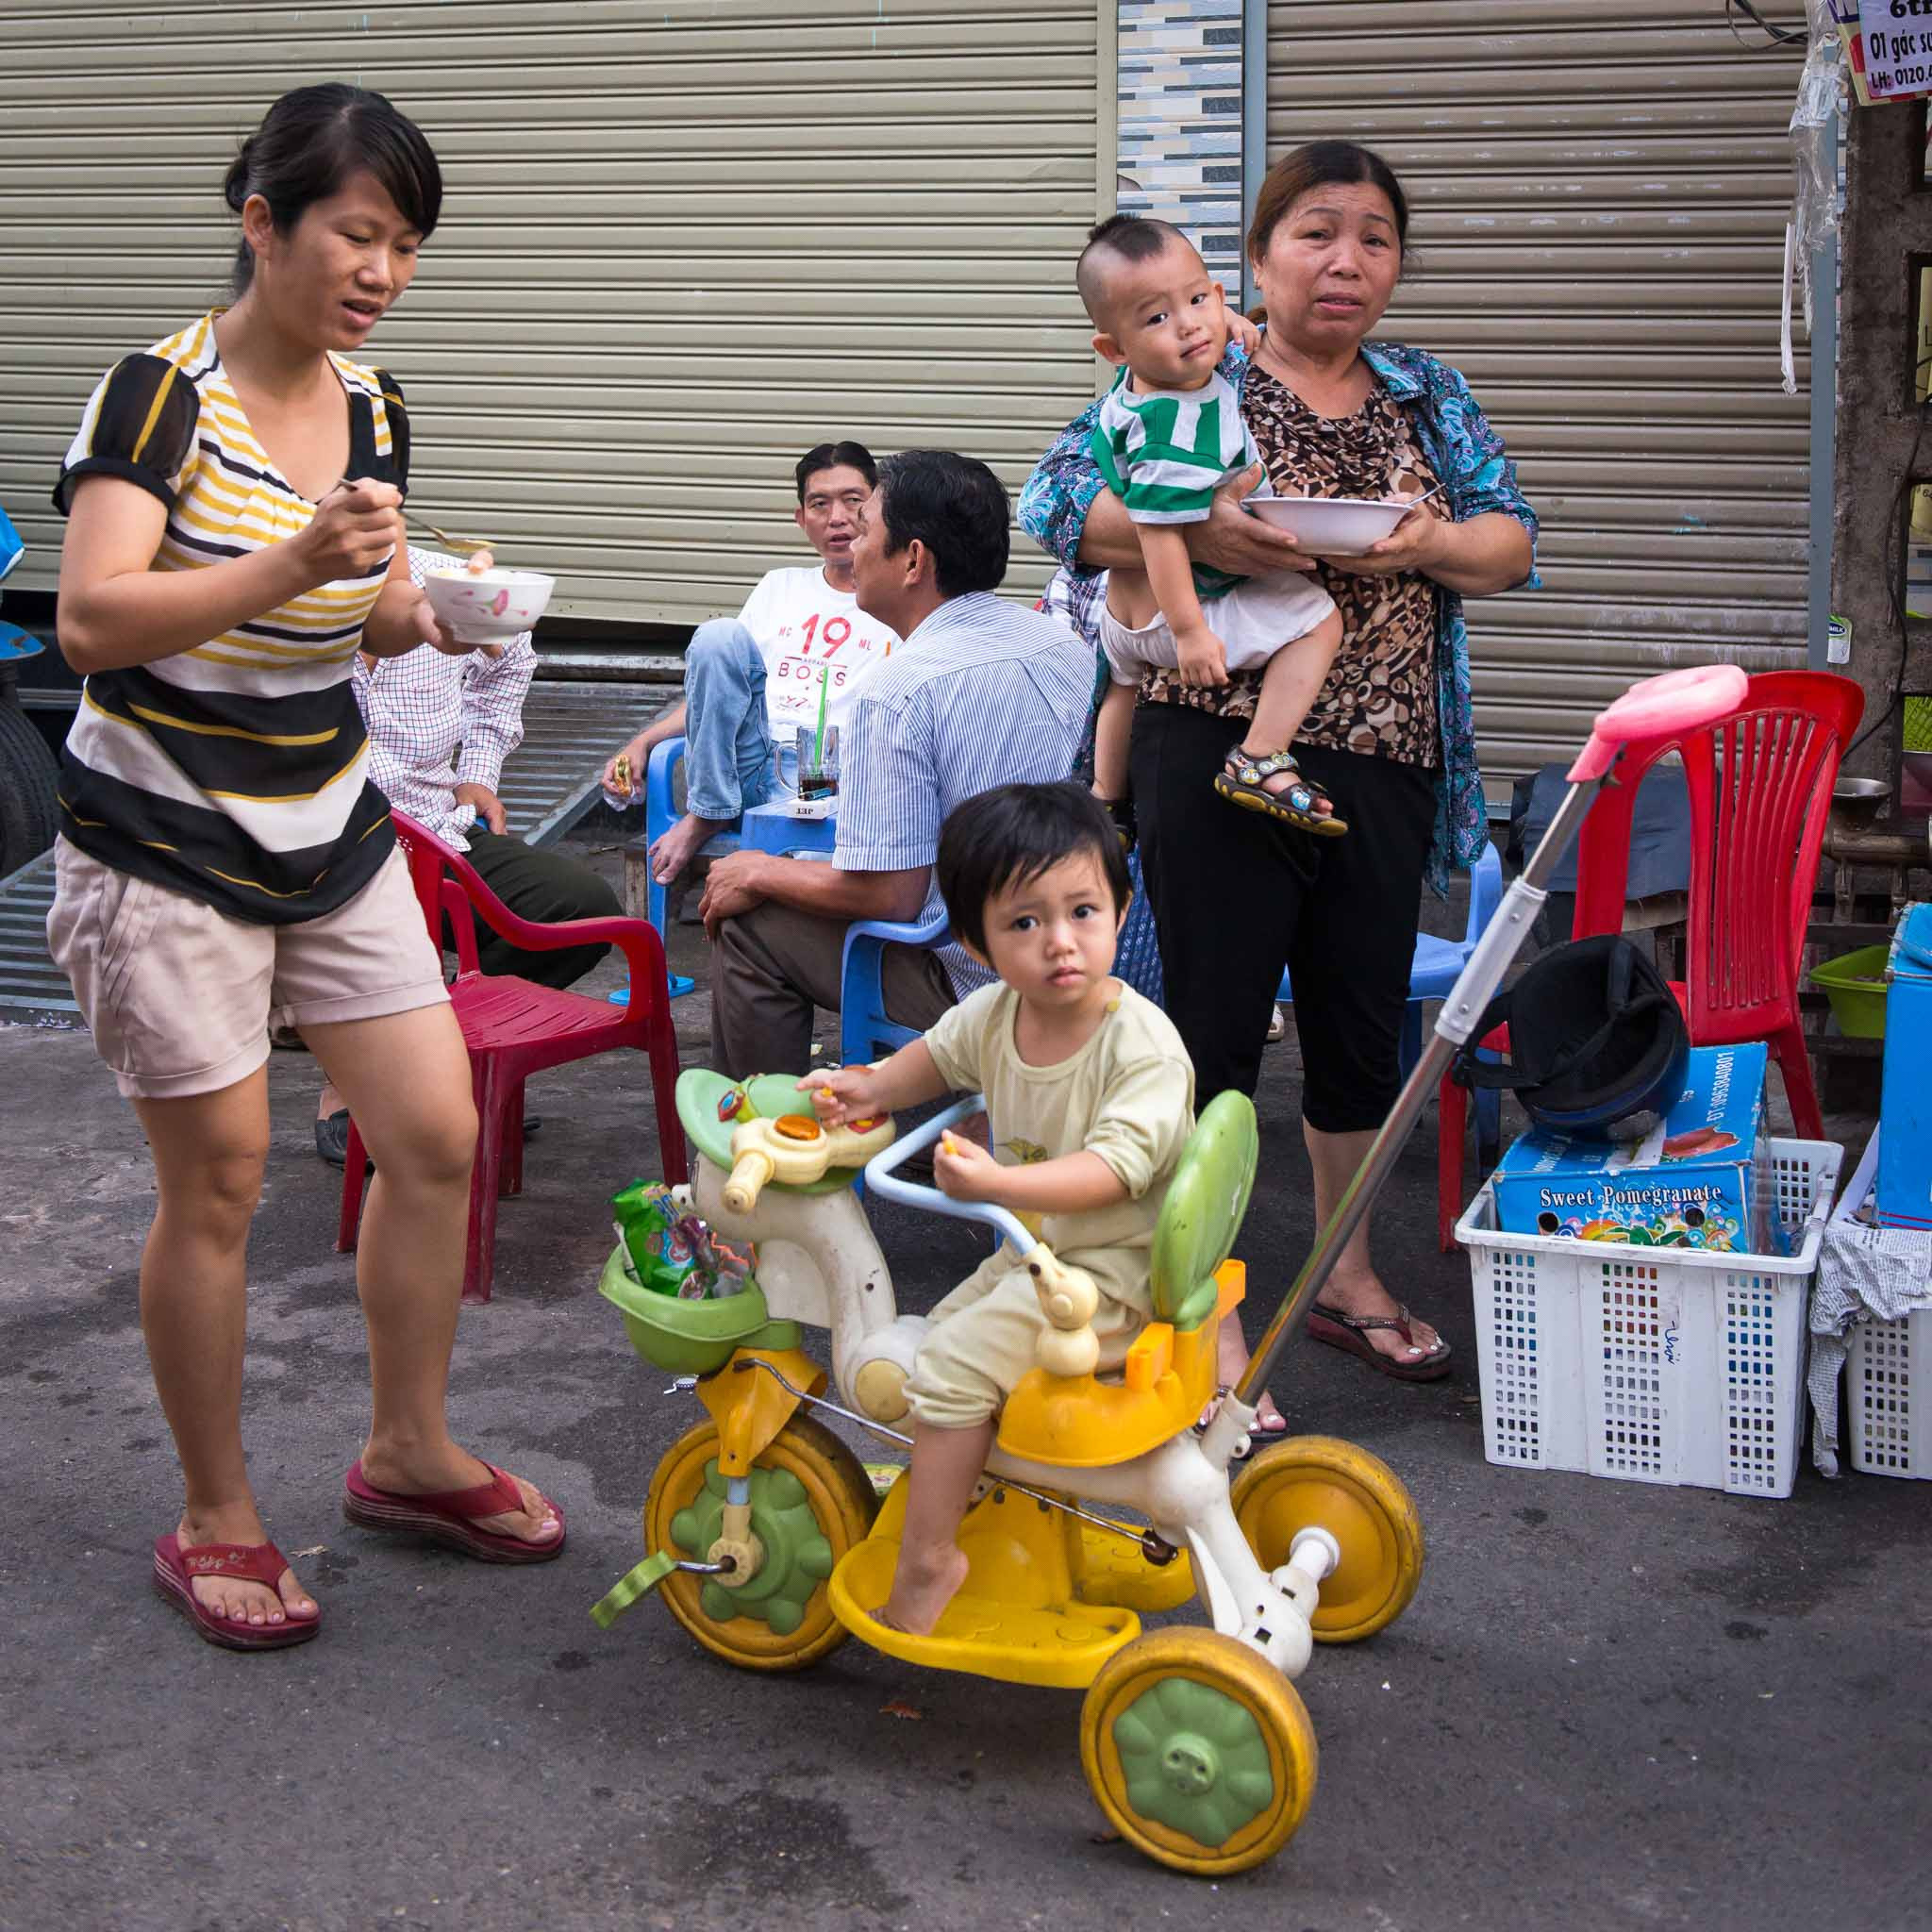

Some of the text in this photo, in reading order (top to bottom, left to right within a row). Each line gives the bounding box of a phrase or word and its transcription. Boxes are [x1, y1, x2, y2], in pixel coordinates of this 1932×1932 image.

[1870, 32, 1887, 59] 01
[1891, 29, 1916, 63] gác
[1871, 71, 1891, 89] LH:
[801, 613, 852, 658] 19
[778, 662, 846, 687] BOSS
[1540, 1184, 1723, 1208] Sweet Pomegranate
